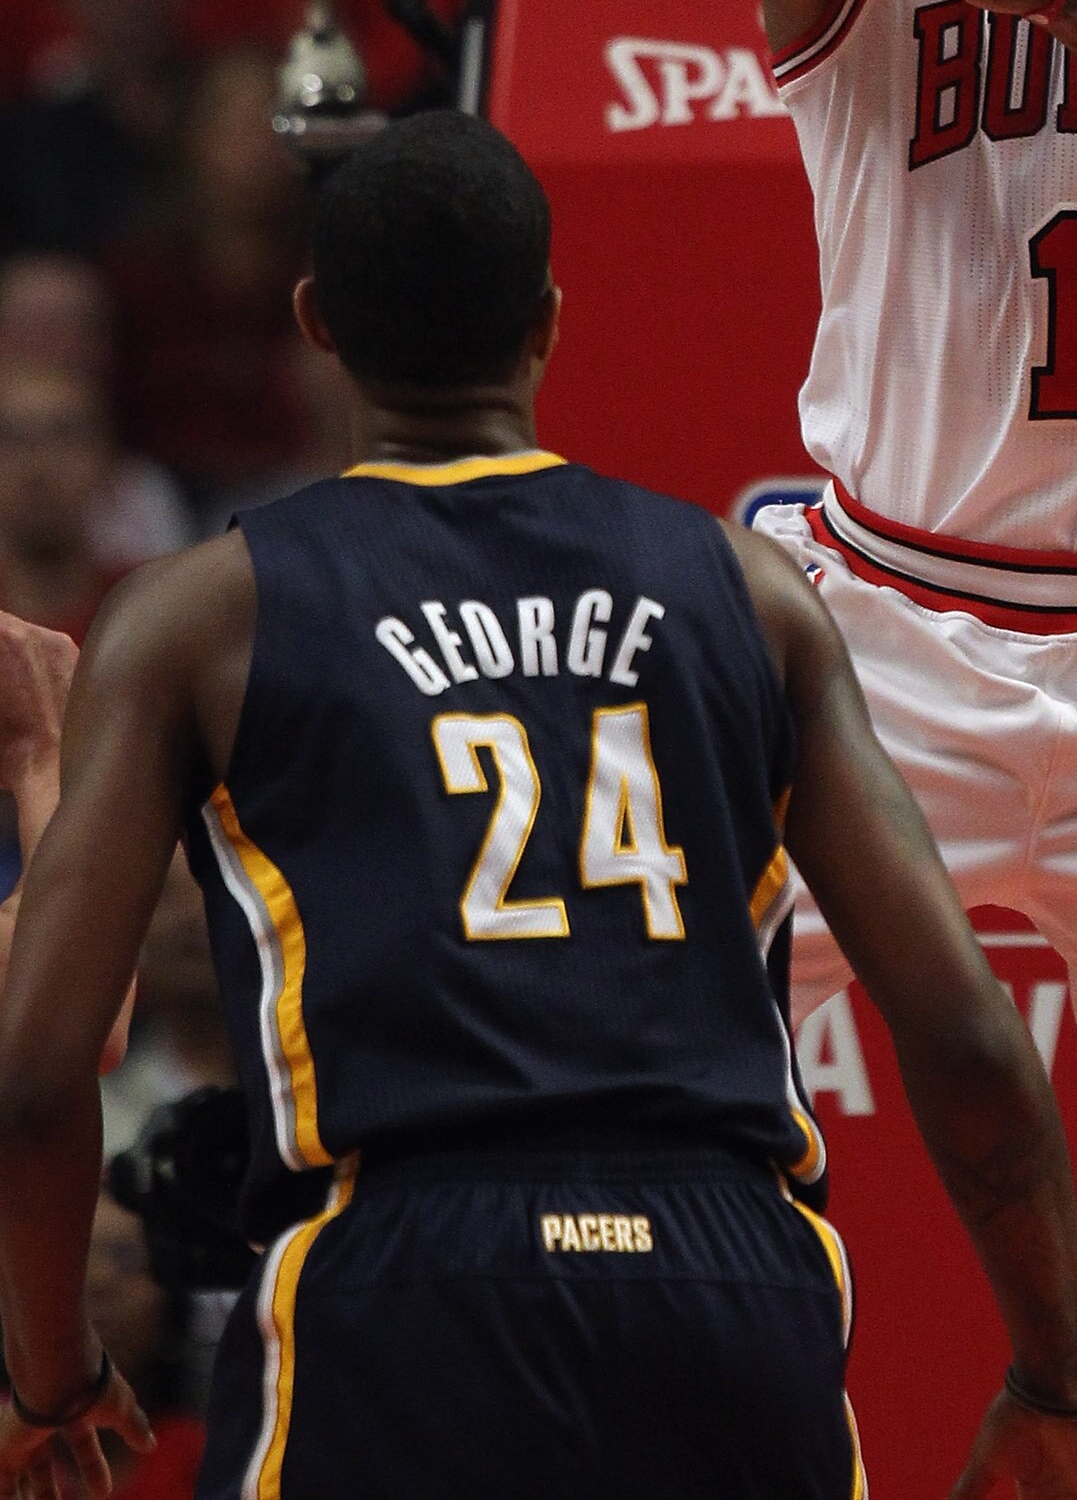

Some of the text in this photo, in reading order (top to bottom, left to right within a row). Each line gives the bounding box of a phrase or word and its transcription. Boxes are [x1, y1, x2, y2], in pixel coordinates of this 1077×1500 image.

[375, 588, 666, 697] GEORGE
[431, 701, 689, 941] 24
[541, 1212, 653, 1253] PACERS
